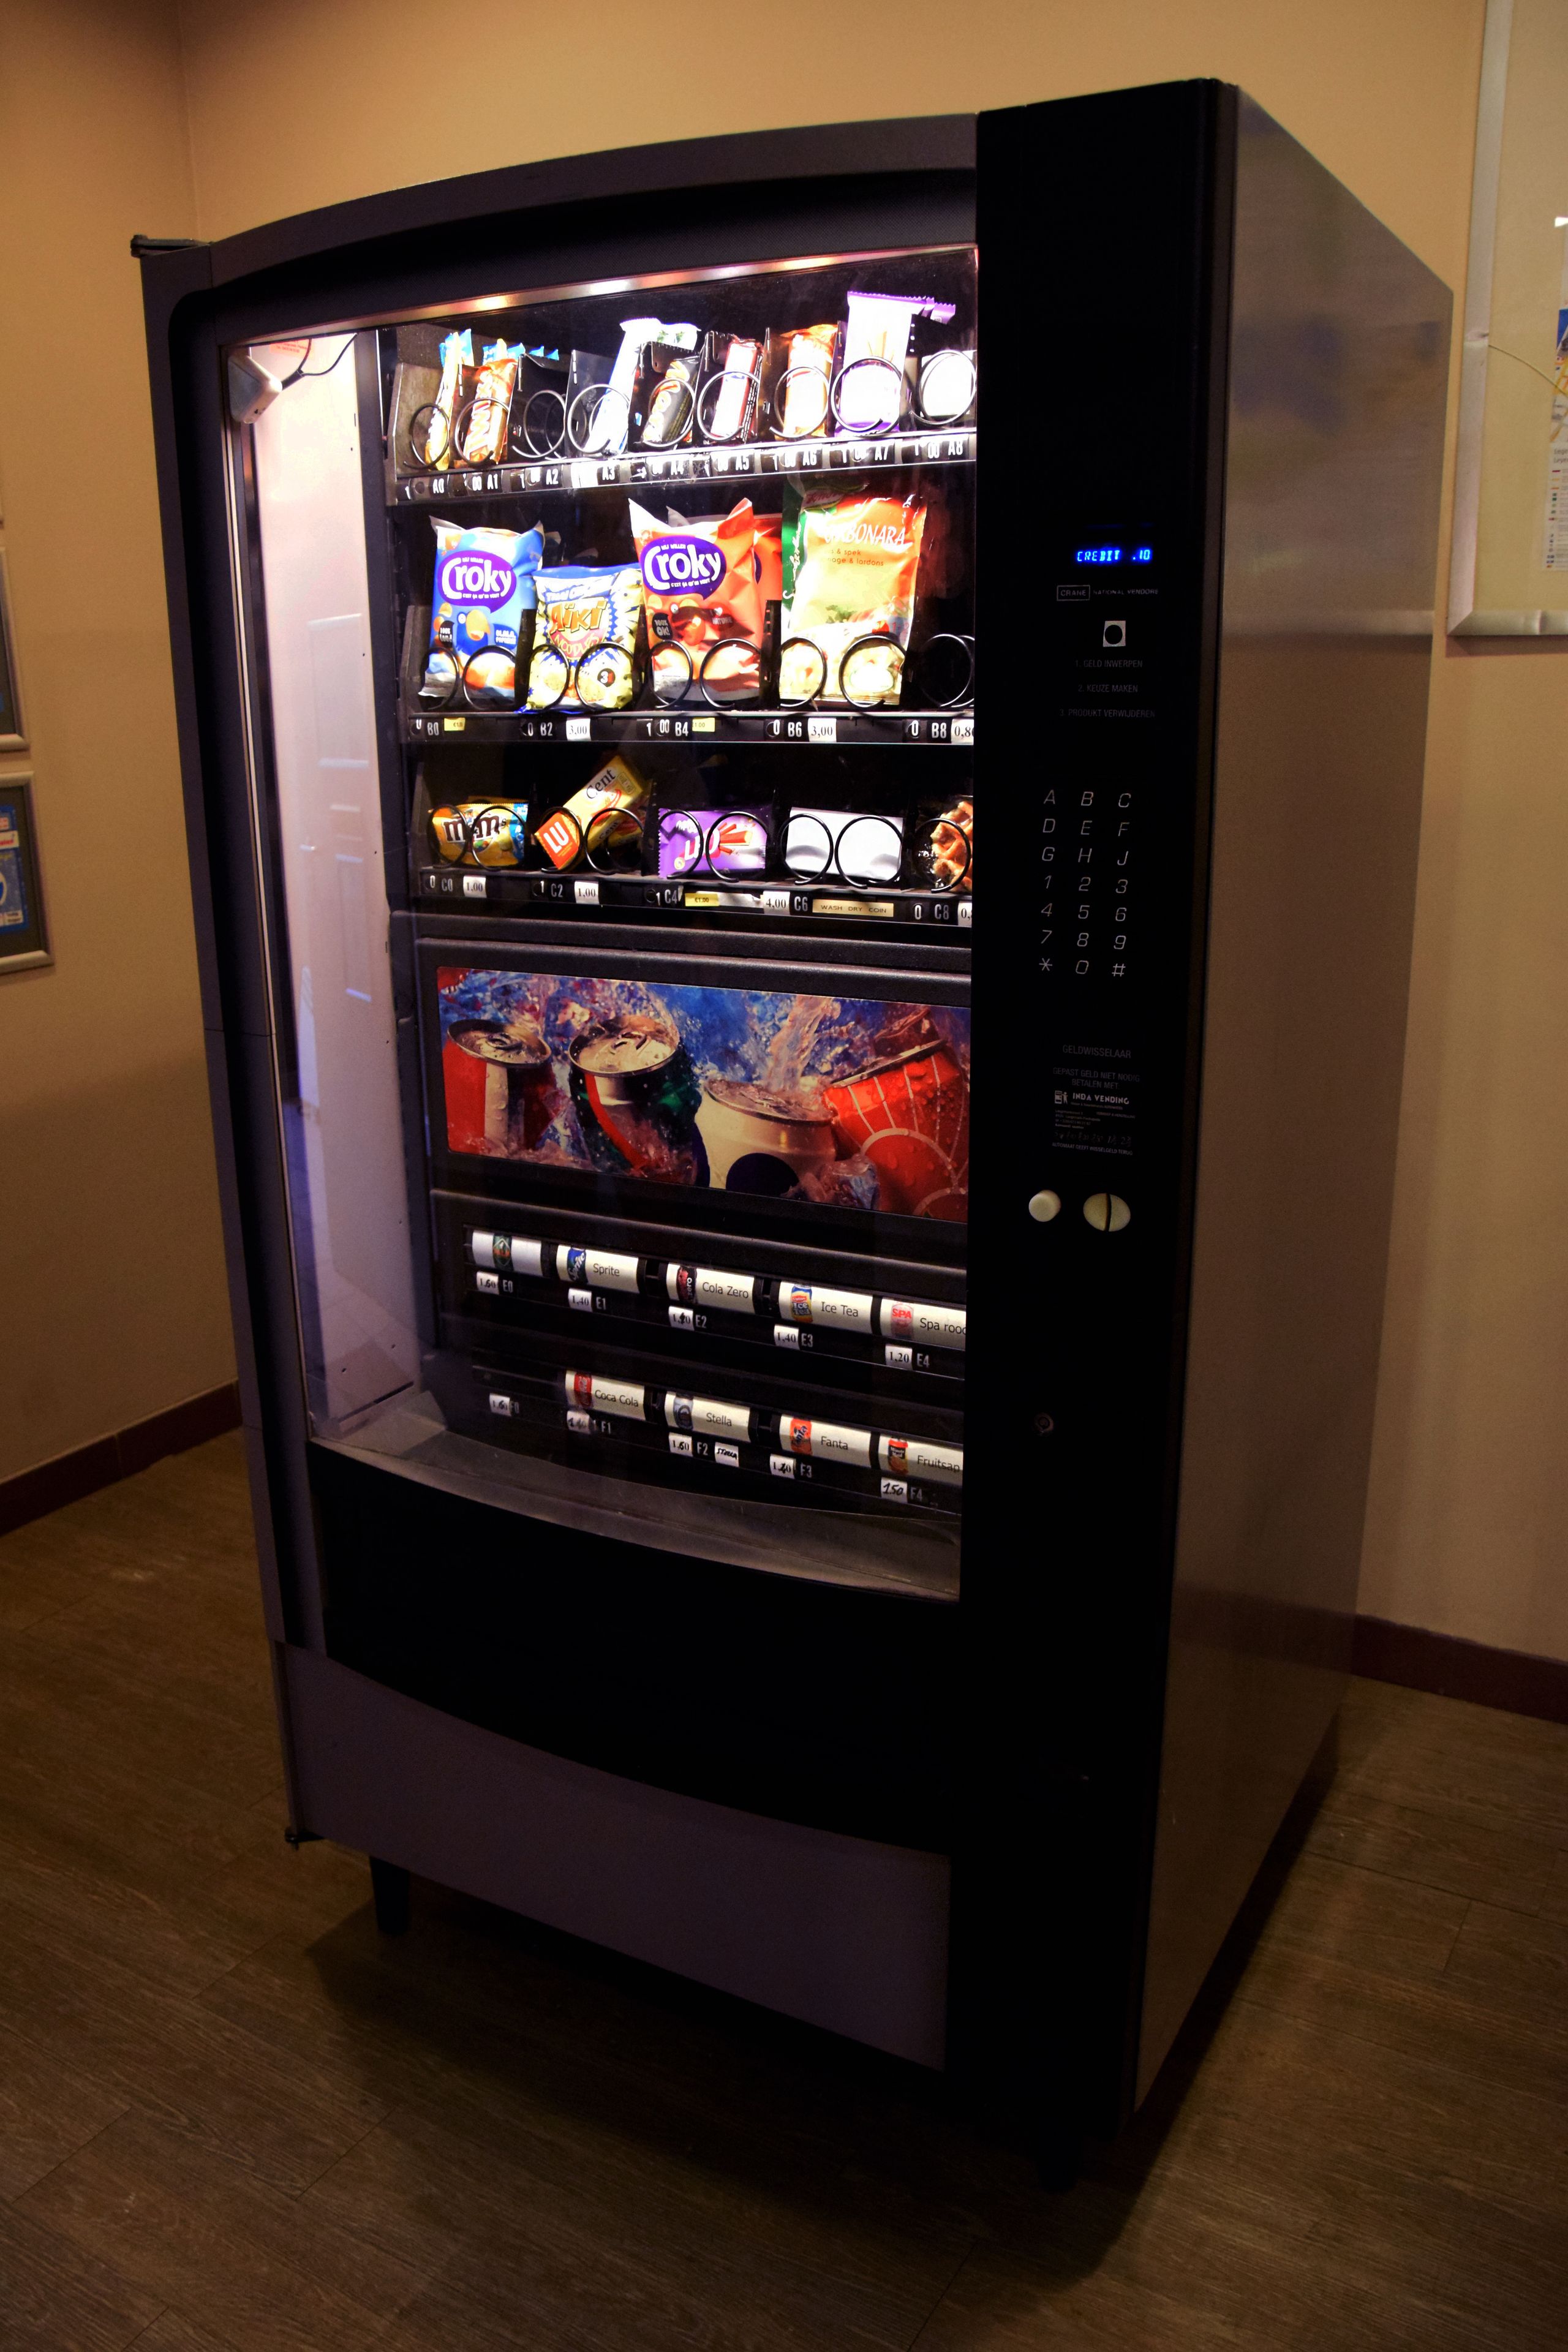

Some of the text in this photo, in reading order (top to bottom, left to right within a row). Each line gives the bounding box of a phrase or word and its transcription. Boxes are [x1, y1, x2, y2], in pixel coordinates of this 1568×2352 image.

[875, 446, 889, 461] A7
[948, 441, 963, 455] A8
[735, 456, 749, 470] A5
[802, 451, 817, 466] A6
[546, 468, 559, 484] A2
[602, 466, 615, 481] A3
[432, 478, 445, 494] A0
[487, 473, 498, 490] A1
[1077, 549, 1120, 562] CREDIT
[644, 544, 721, 590] Croky
[442, 557, 512, 600] Croky
[656, 626, 670, 636] OK!
[1104, 660, 1143, 668] INWERPEN
[1112, 684, 1139, 693] MAKEN
[1104, 709, 1156, 718] VERWIJDEREN
[428, 722, 439, 736] B0
[540, 722, 553, 736] B2
[569, 725, 587, 736] 3,00
[675, 722, 688, 736] B4
[788, 722, 802, 737] B6
[810, 725, 834, 737] 3,00
[931, 722, 947, 739] B8
[954, 725, 974, 739] 0,8
[586, 769, 616, 799] Cent
[1043, 789, 1055, 804] A
[1080, 791, 1094, 806] B
[1118, 793, 1131, 808] C
[1042, 818, 1055, 833] D
[1080, 820, 1093, 835] E
[1118, 821, 1130, 837] F
[543, 821, 570, 854] LU
[1041, 846, 1055, 862] G
[1078, 848, 1092, 863] H
[1117, 851, 1129, 865] J
[441, 878, 453, 892] C0
[466, 882, 483, 892] 1,00
[1044, 875, 1052, 889] 1
[1078, 876, 1091, 891] 2
[1115, 879, 1128, 894] 3
[551, 883, 564, 897] C2
[578, 888, 597, 898] 1,00
[664, 889, 677, 904] C4
[766, 899, 786, 910] 4,00
[794, 896, 809, 911] C6
[934, 903, 949, 920] C8
[1041, 902, 1053, 917] 4
[1078, 905, 1090, 919] 5
[1115, 907, 1127, 922] 6
[1041, 929, 1053, 944] 7
[1077, 932, 1089, 947] 8
[1113, 935, 1126, 949] 9
[1063, 1044, 1132, 1059] GELDWISSELAAR
[1053, 1067, 1140, 1082] GEPAST GELD NIET NODIG
[1071, 1078, 1102, 1088] BETALEN
[1072, 1092, 1129, 1105] INDA VENDING
[592, 1264, 620, 1277] Sprite
[502, 1280, 513, 1294] E0
[702, 1281, 749, 1299] Cola Zero
[596, 1297, 606, 1310] E1
[821, 1302, 859, 1317] Ice Tea
[892, 1308, 912, 1319] SPA
[695, 1314, 707, 1329] E2
[919, 1317, 940, 1331] Spa
[801, 1333, 813, 1348] E3
[916, 1352, 930, 1368] E4
[595, 1389, 639, 1408] Coca Cola
[706, 1412, 732, 1427] Stella
[601, 1421, 611, 1434] F1
[696, 1441, 709, 1456] F2
[820, 1436, 848, 1450] Fanta
[800, 1462, 812, 1478] F3
[917, 1455, 960, 1473] Fruitsap
[910, 1486, 922, 1502] F4
